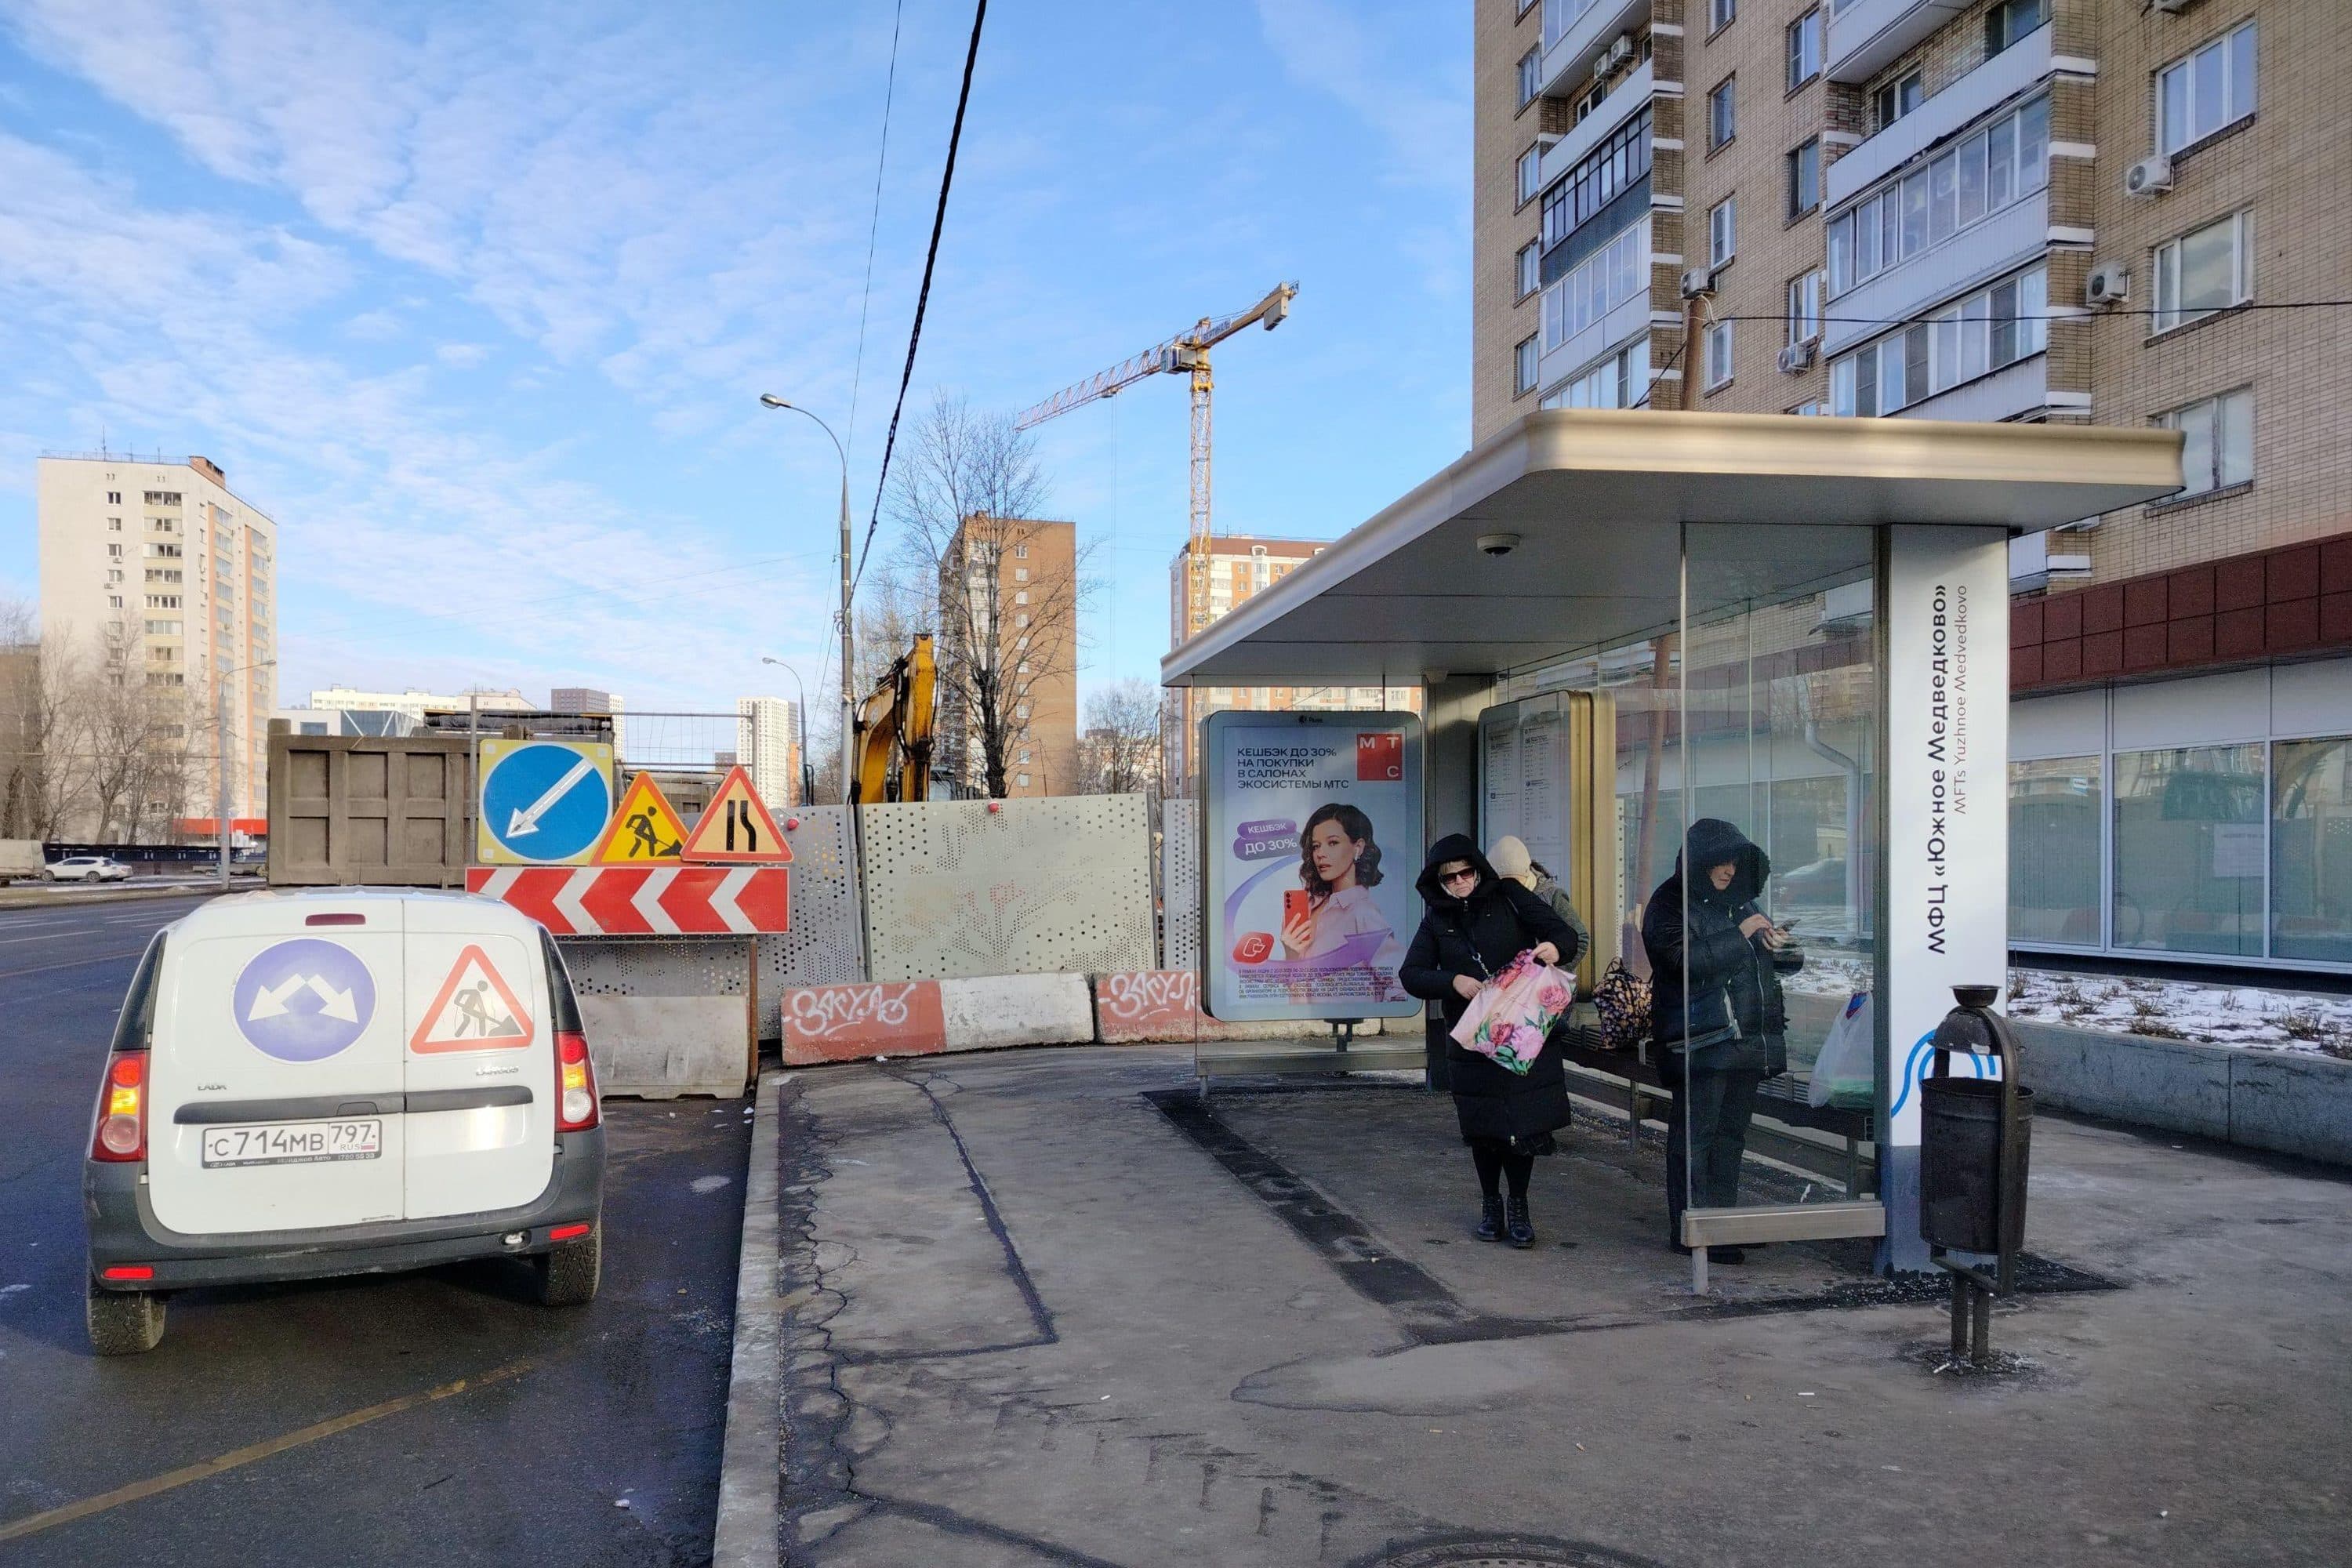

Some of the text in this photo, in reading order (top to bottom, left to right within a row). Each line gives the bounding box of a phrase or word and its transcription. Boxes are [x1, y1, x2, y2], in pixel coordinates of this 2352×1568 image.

[1953, 585, 1967, 815] MFTs Yuzhnoe Medvedkovo
[1237, 748, 1337, 758] КЕШБЭК ДО 30%
[1237, 758, 1314, 768] НА ПОКУПКИ
[1237, 769, 1306, 778] В САЛОНАХ
[1927, 584, 1949, 955] МФЦ «Южное Медведково»
[1237, 779, 1349, 789] ЭКОСИСТЕМЫ МТС
[1247, 822, 1287, 834] КЕШБЭК
[1245, 838, 1298, 855] ДО 30%
[330, 1124, 372, 1144] 797
